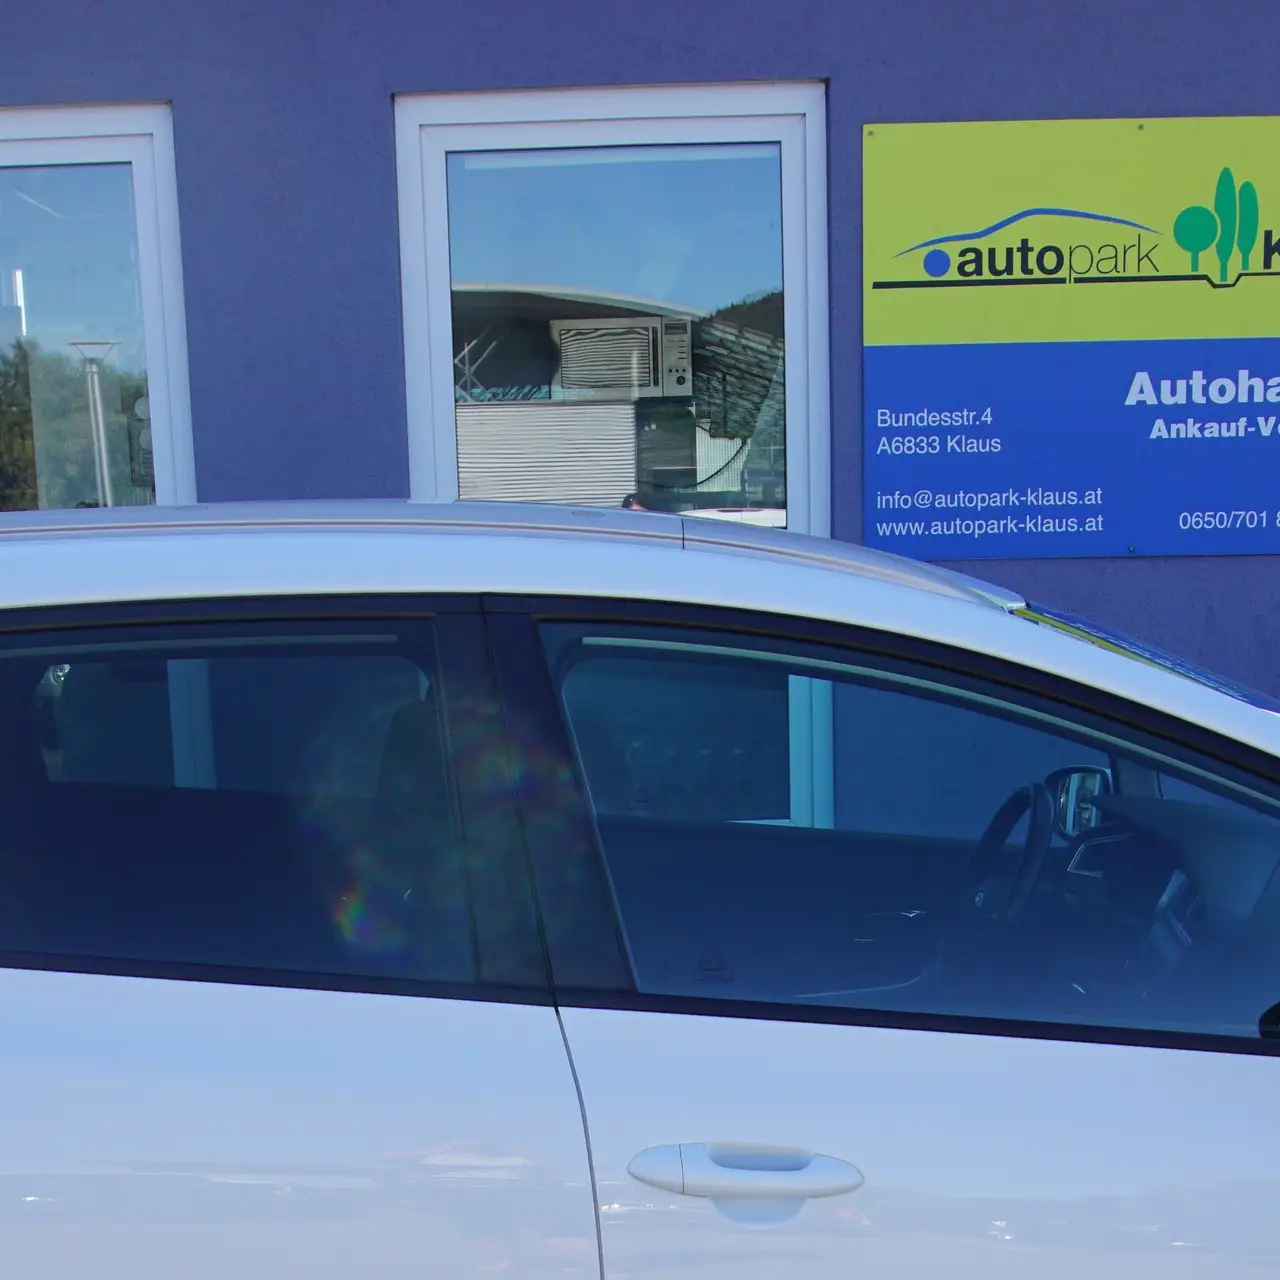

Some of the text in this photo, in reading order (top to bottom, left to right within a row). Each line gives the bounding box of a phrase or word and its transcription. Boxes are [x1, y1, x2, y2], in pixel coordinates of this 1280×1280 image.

[956, 233, 1160, 284] autopark
[876, 407, 994, 427] Bundesstr.4
[876, 434, 1002, 455] A6833 Klaus
[876, 487, 1103, 511] info@autopark-klaus.at
[876, 514, 1104, 538] www.autopark-klaus.at
[1179, 510, 1267, 530] 0650/701
